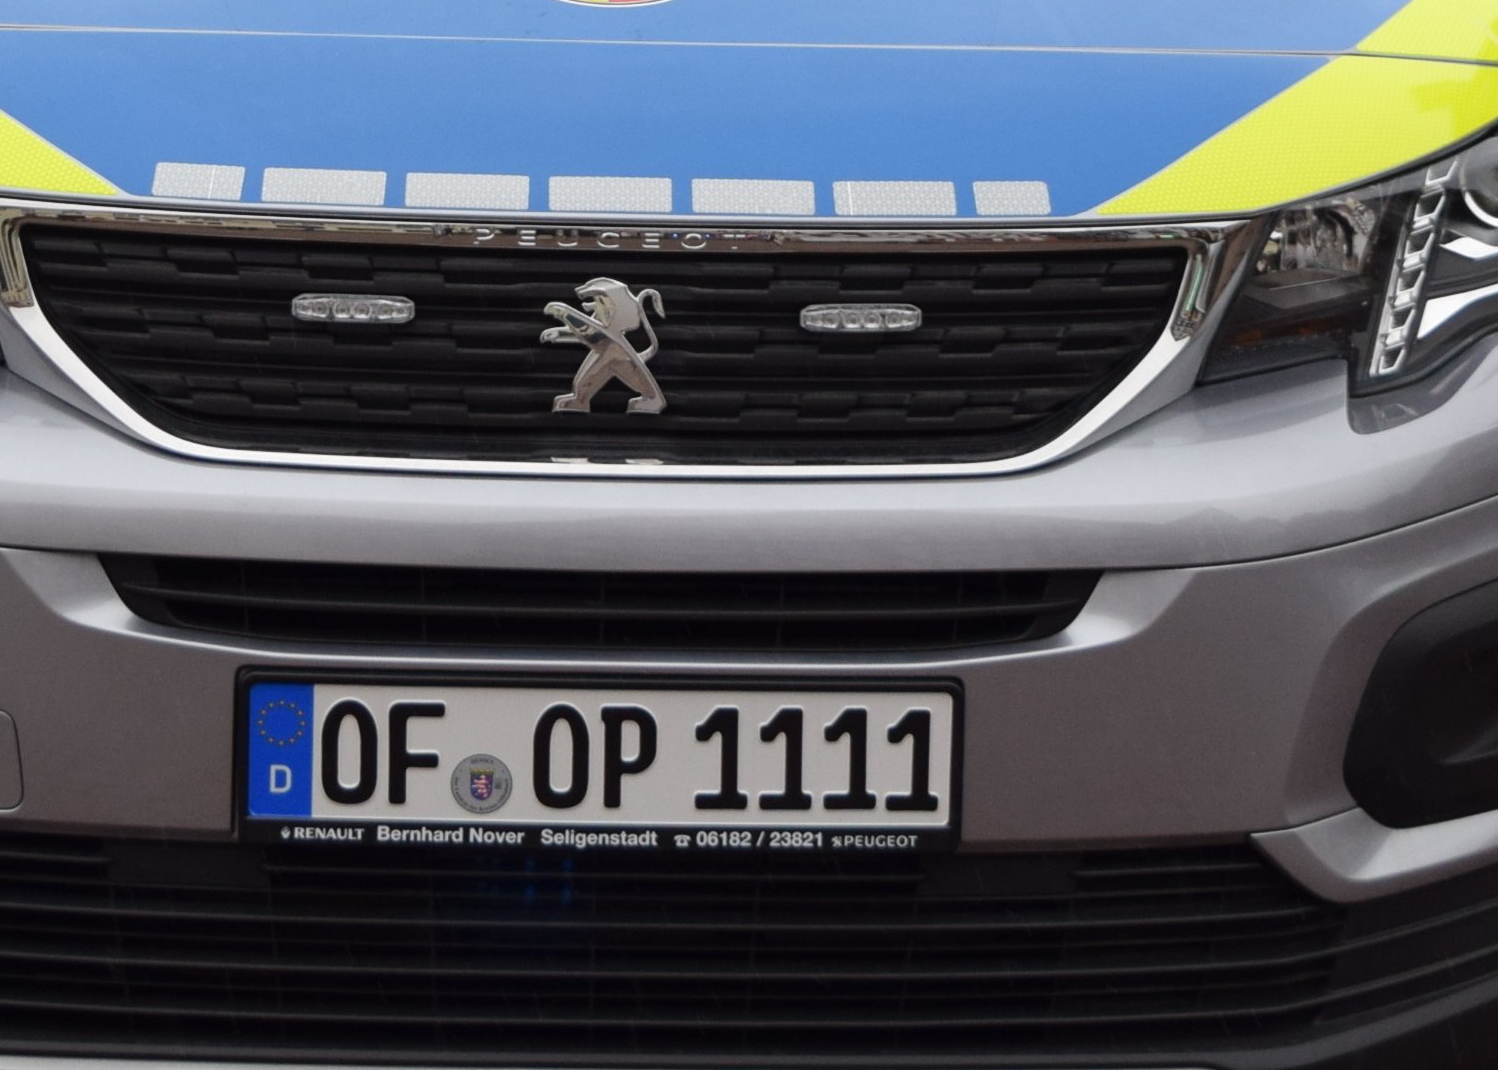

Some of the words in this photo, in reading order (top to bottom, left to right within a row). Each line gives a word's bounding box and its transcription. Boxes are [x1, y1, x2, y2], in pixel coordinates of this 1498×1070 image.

[321, 699, 446, 805] OF
[533, 703, 657, 809] OP
[694, 706, 939, 812] 1111
[269, 764, 292, 794] D
[293, 826, 365, 840] RENAULT
[377, 825, 464, 843] Bernhard
[469, 827, 526, 844] Nover
[541, 828, 658, 849] Seligenstadt
[696, 831, 752, 847] 06182
[769, 831, 824, 848] 23821
[843, 834, 918, 849] PEUGEOT
